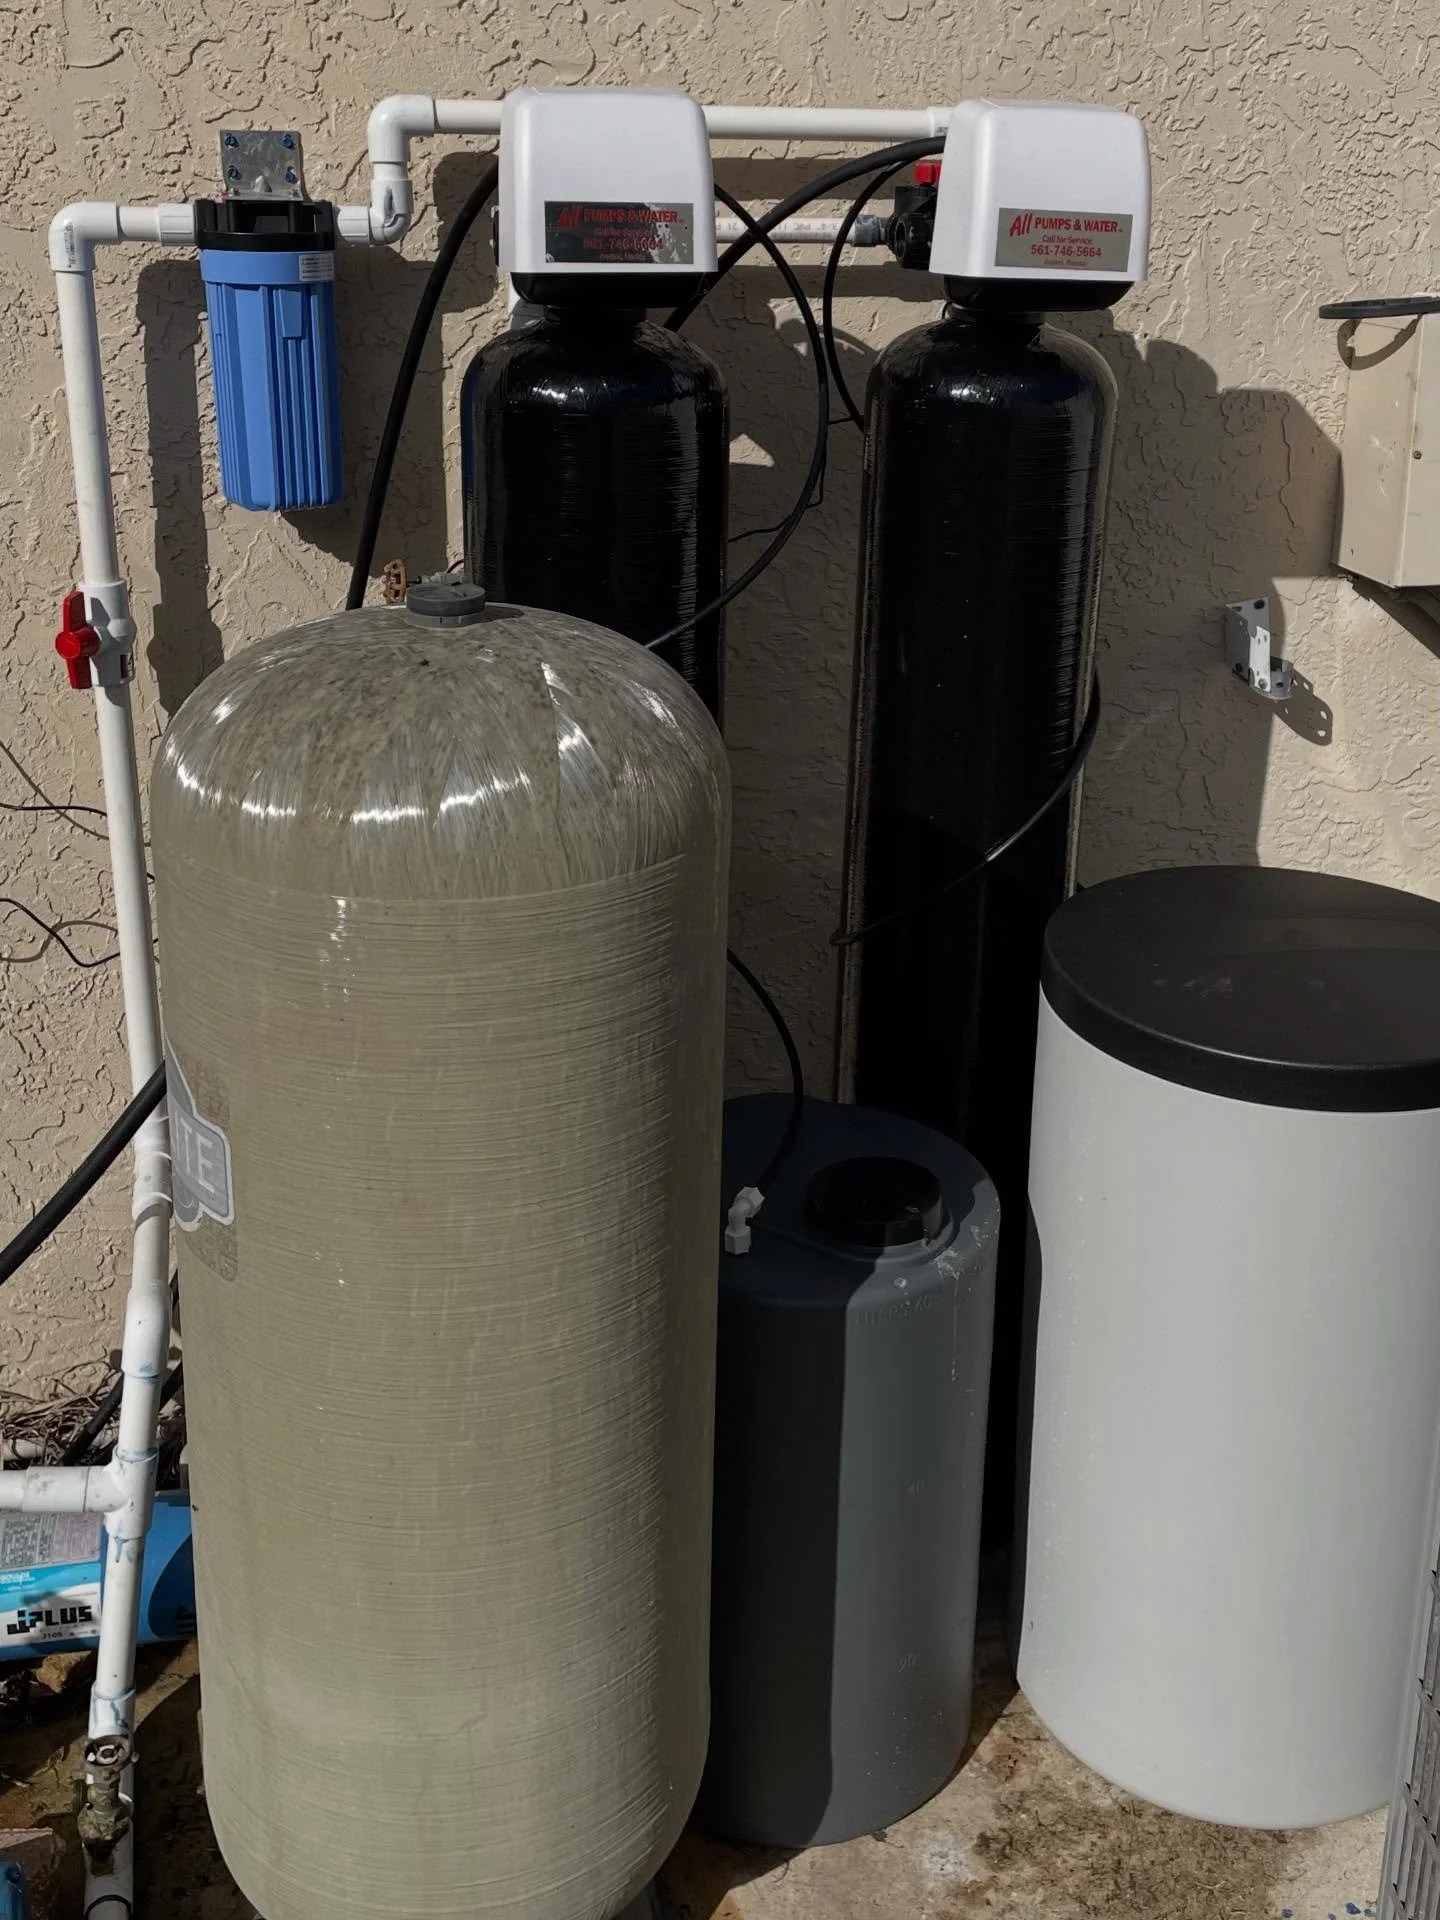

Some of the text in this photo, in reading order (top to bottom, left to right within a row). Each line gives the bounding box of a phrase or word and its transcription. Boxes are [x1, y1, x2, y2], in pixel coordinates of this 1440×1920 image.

[583, 208, 624, 221] PUMPS
[627, 209, 636, 221] &
[638, 210, 678, 223] WATER
[1008, 212, 1118, 237] All PUMPS & WATER
[1041, 234, 1093, 245] Call for Service
[1030, 244, 1102, 258] 561-746-5664
